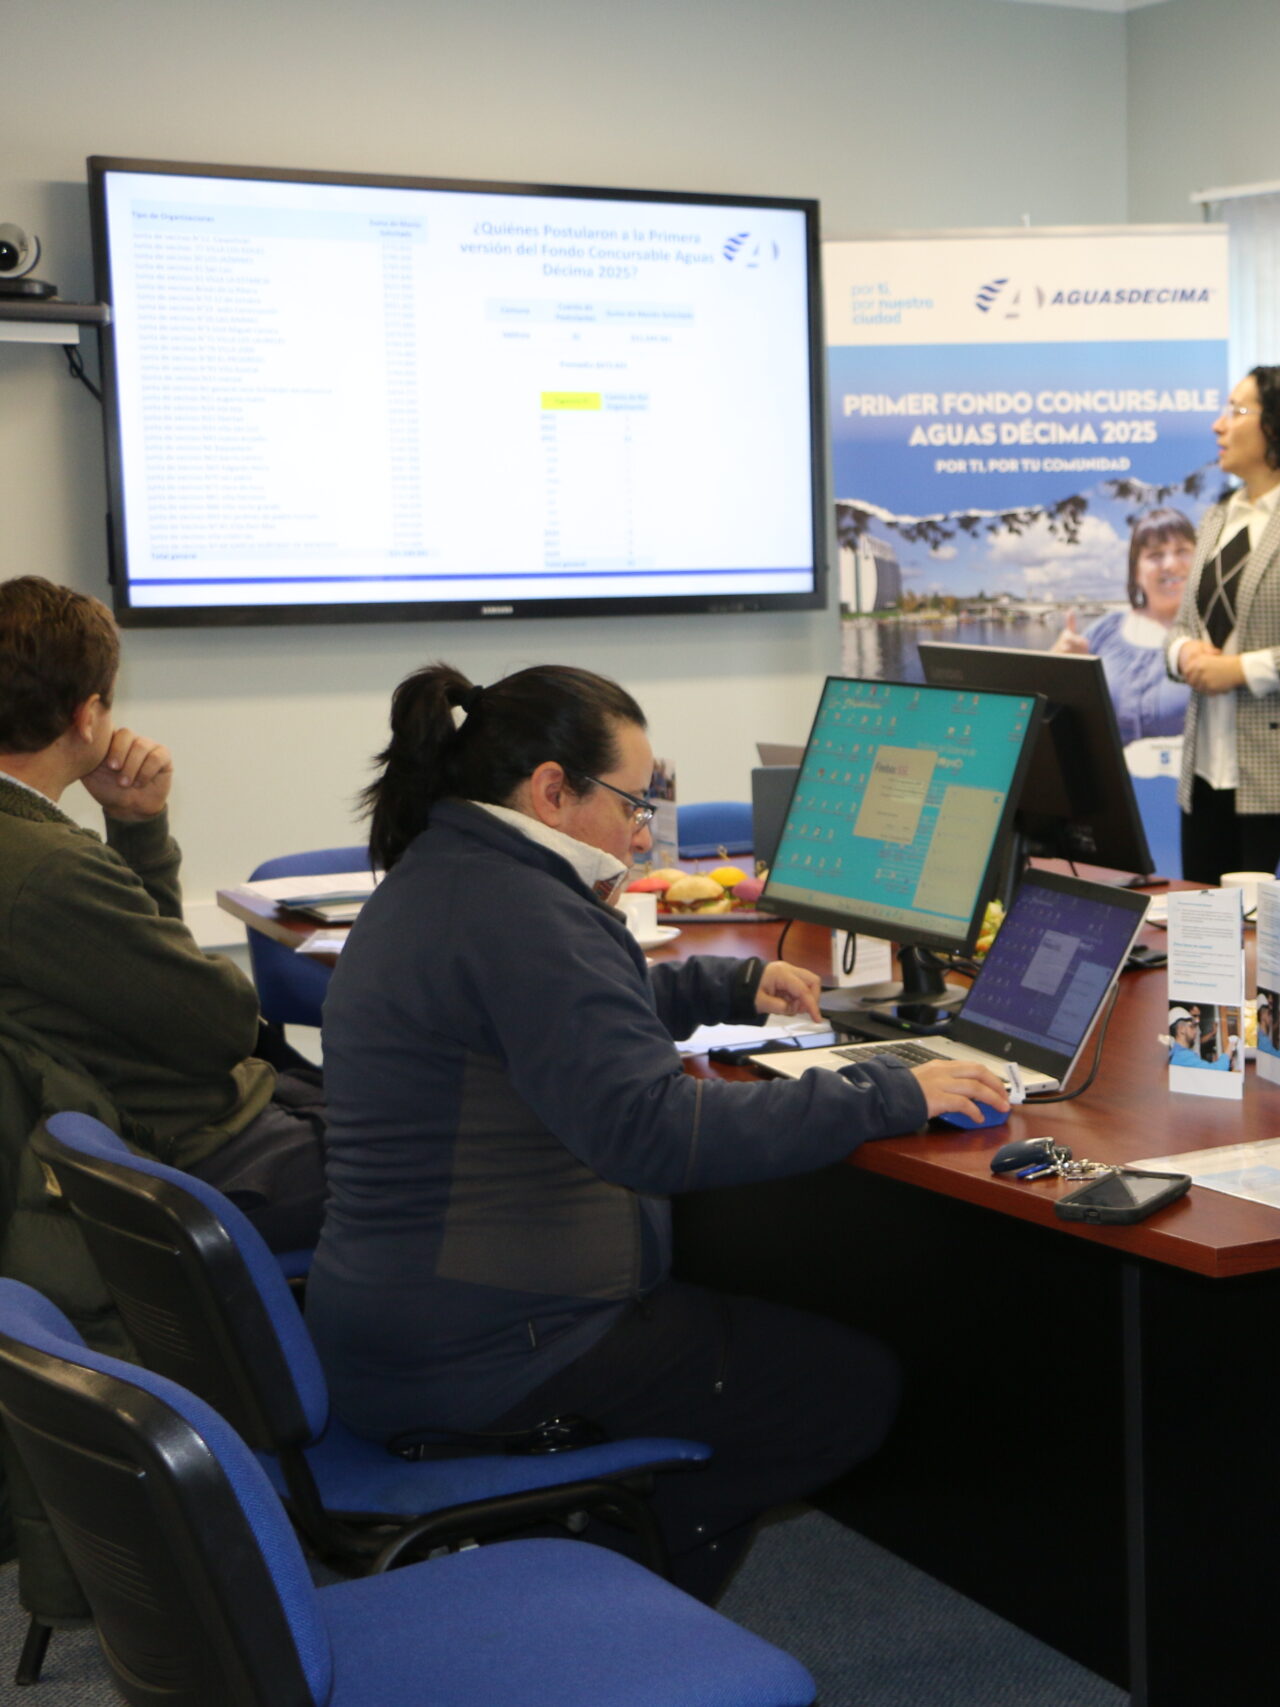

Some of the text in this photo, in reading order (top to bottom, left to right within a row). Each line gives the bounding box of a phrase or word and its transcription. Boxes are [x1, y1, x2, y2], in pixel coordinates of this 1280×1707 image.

[473, 220, 702, 244] ¿Quiénes Postularon a la Primera
[459, 242, 715, 265] versión del Fondo Concursable Aguas
[542, 263, 639, 280] Décima 2025?
[1051, 288, 1211, 306] AGUASDECIMA
[844, 388, 1220, 417] PRIMER FONDO CONCURSABLE
[909, 417, 1158, 446] AGUAS DÉCIMA 2025
[935, 459, 967, 473] POR
[988, 458, 1019, 473] POR
[1021, 457, 1041, 472] TU
[1043, 456, 1131, 472] COMUNIDAD
